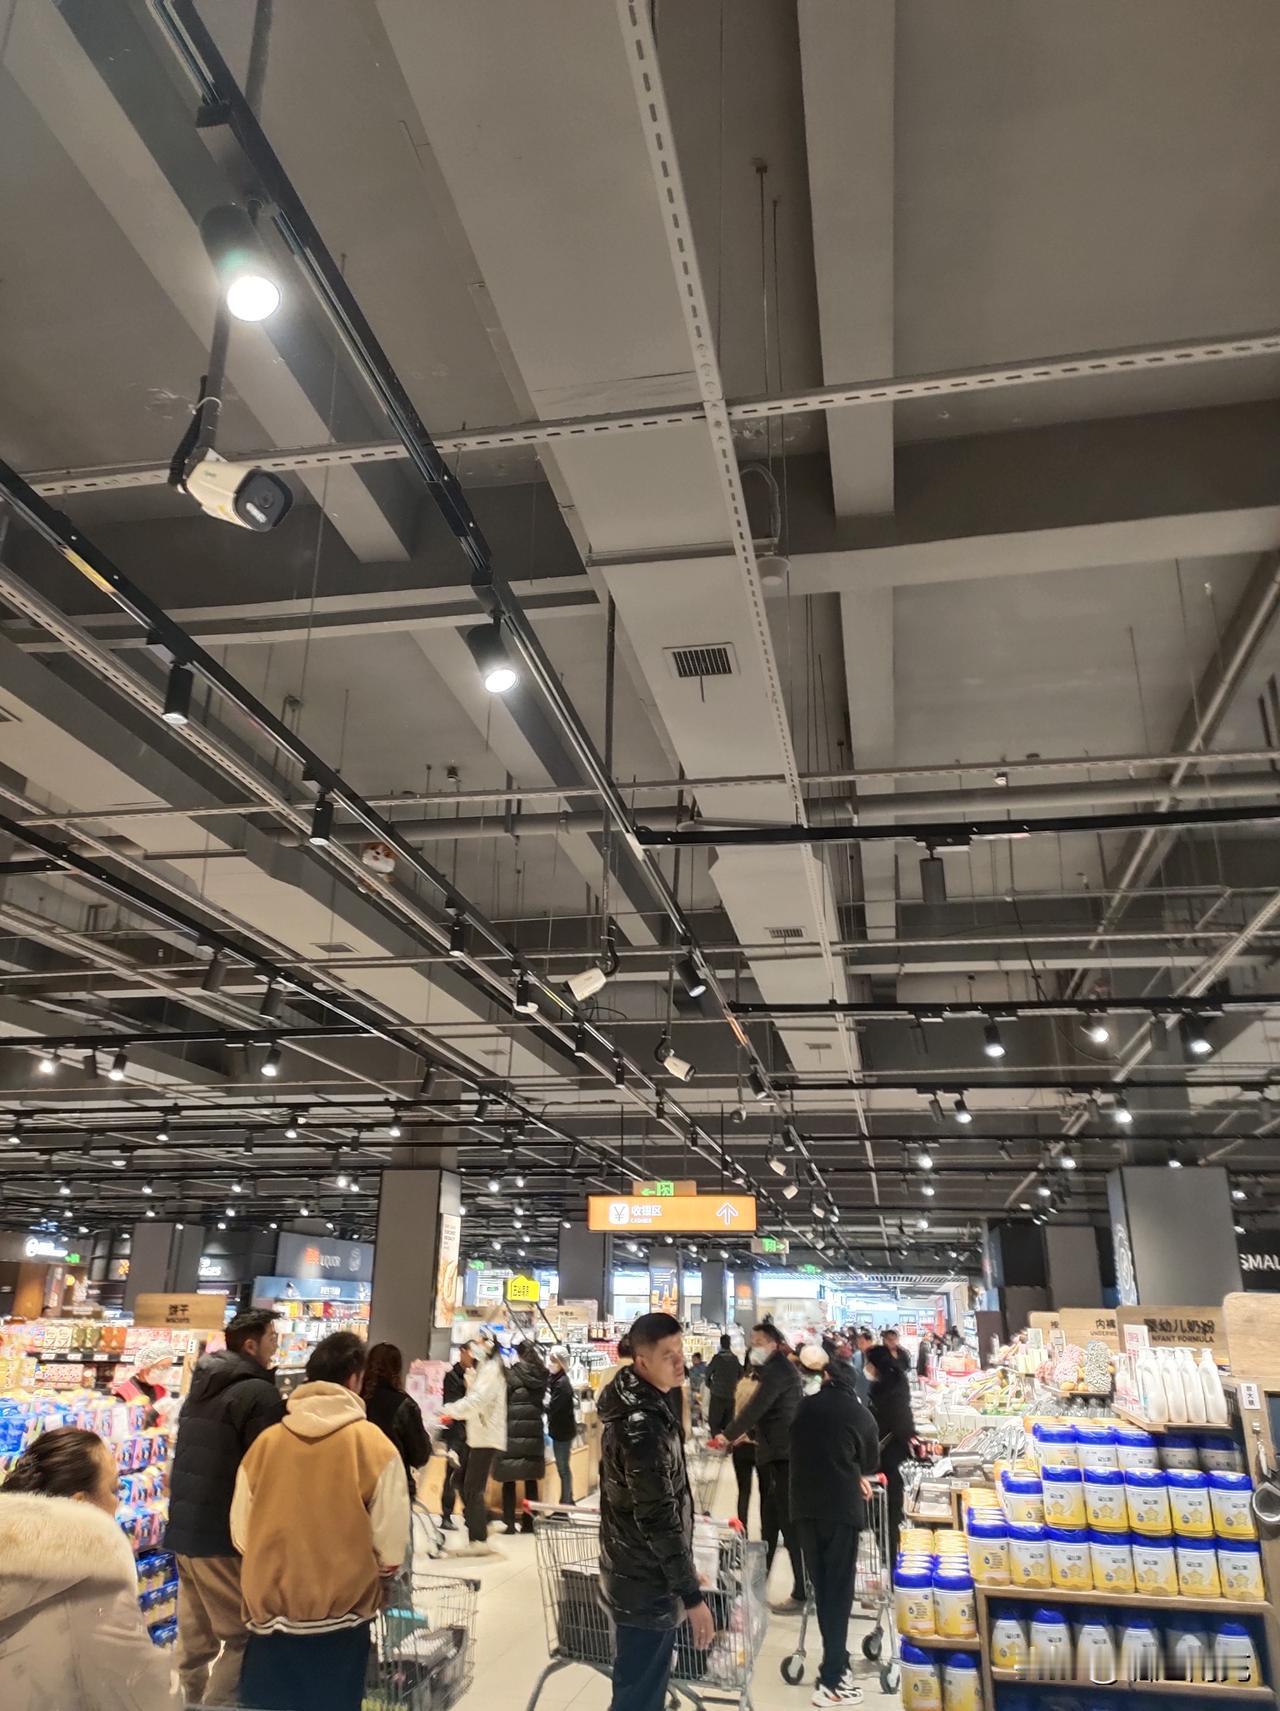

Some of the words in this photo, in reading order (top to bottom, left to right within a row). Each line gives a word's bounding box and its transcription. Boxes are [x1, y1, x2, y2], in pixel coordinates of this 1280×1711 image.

[168, 1303, 190, 1316] 饼干
[1151, 1335, 1176, 1343] NFANT
[1177, 1335, 1216, 1344] FORMULA
